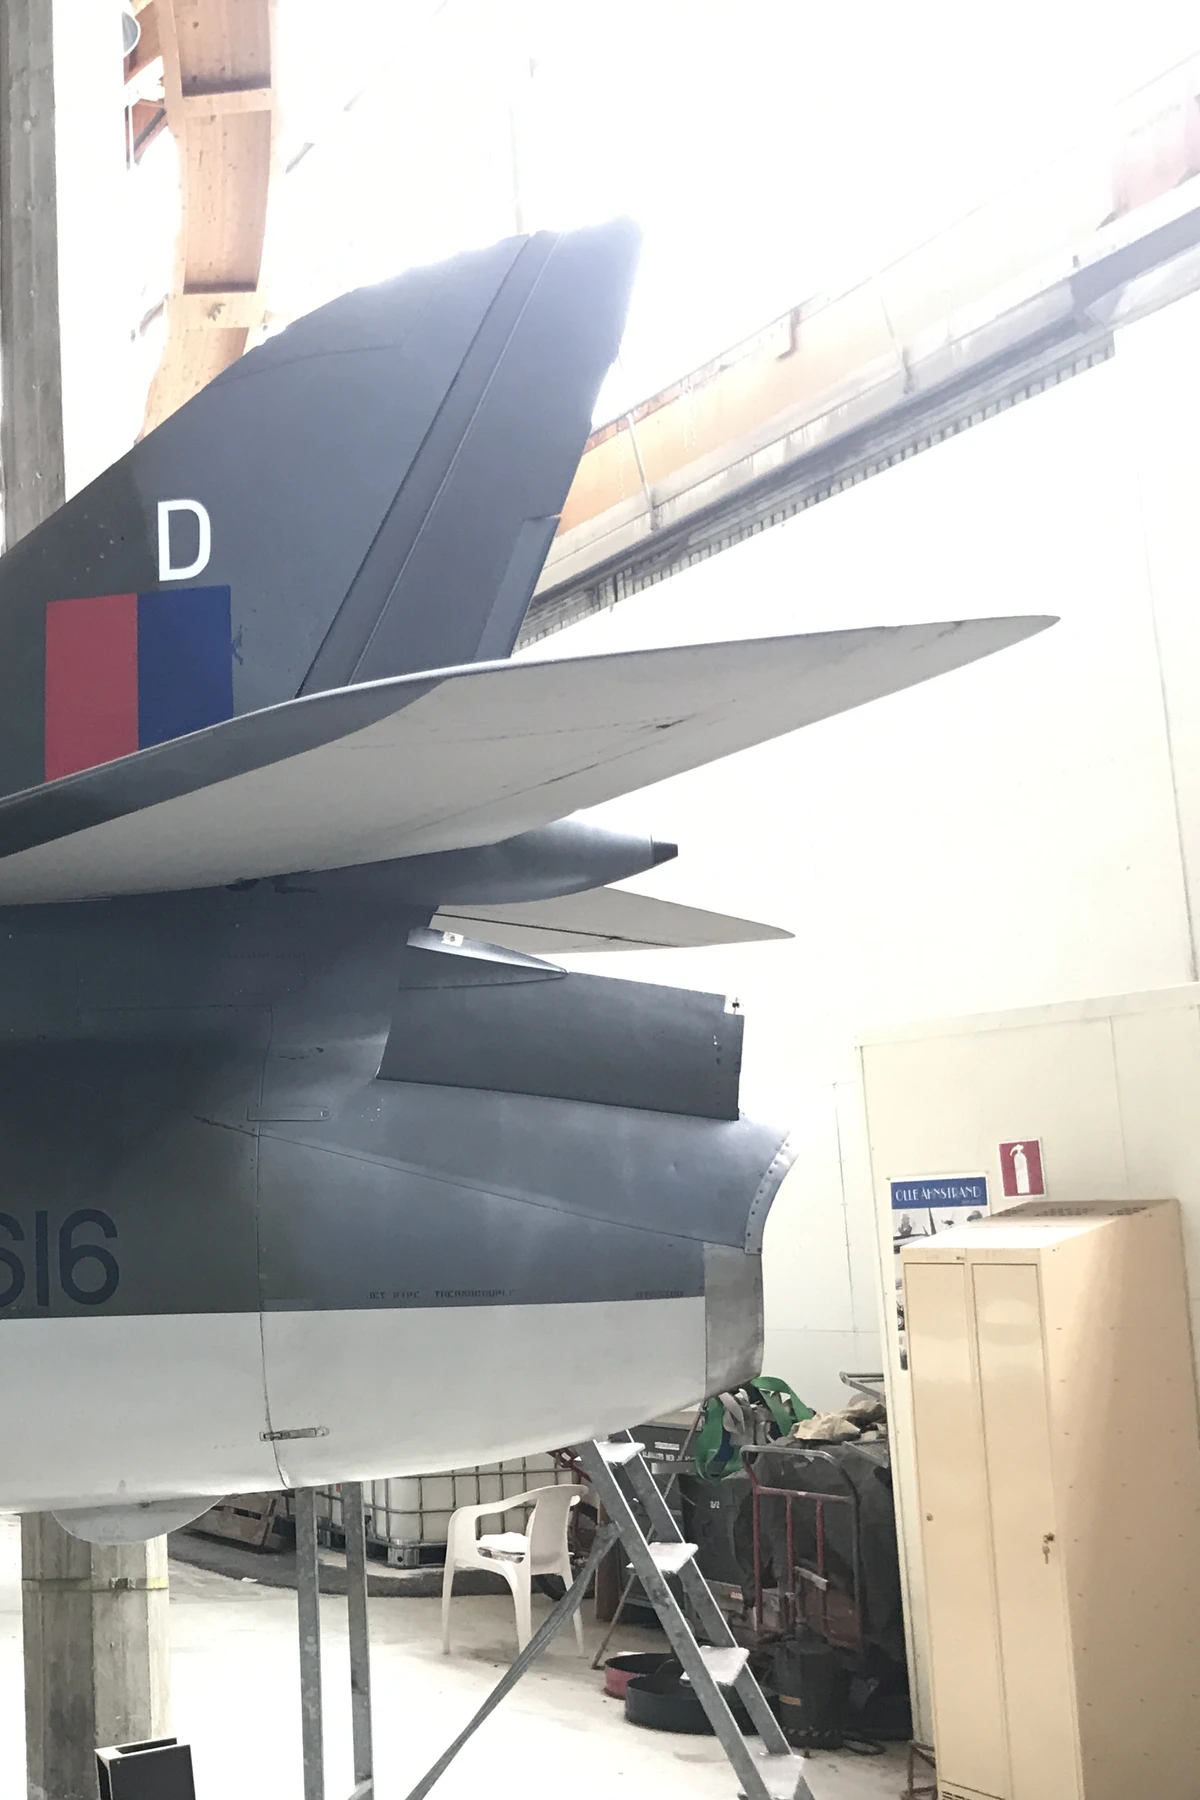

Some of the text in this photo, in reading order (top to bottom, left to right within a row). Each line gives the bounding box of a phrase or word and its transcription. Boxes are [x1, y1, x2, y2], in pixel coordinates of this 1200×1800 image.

[157, 499, 211, 582] D
[895, 1185, 982, 1202] OLLE ÅHNSTRAND
